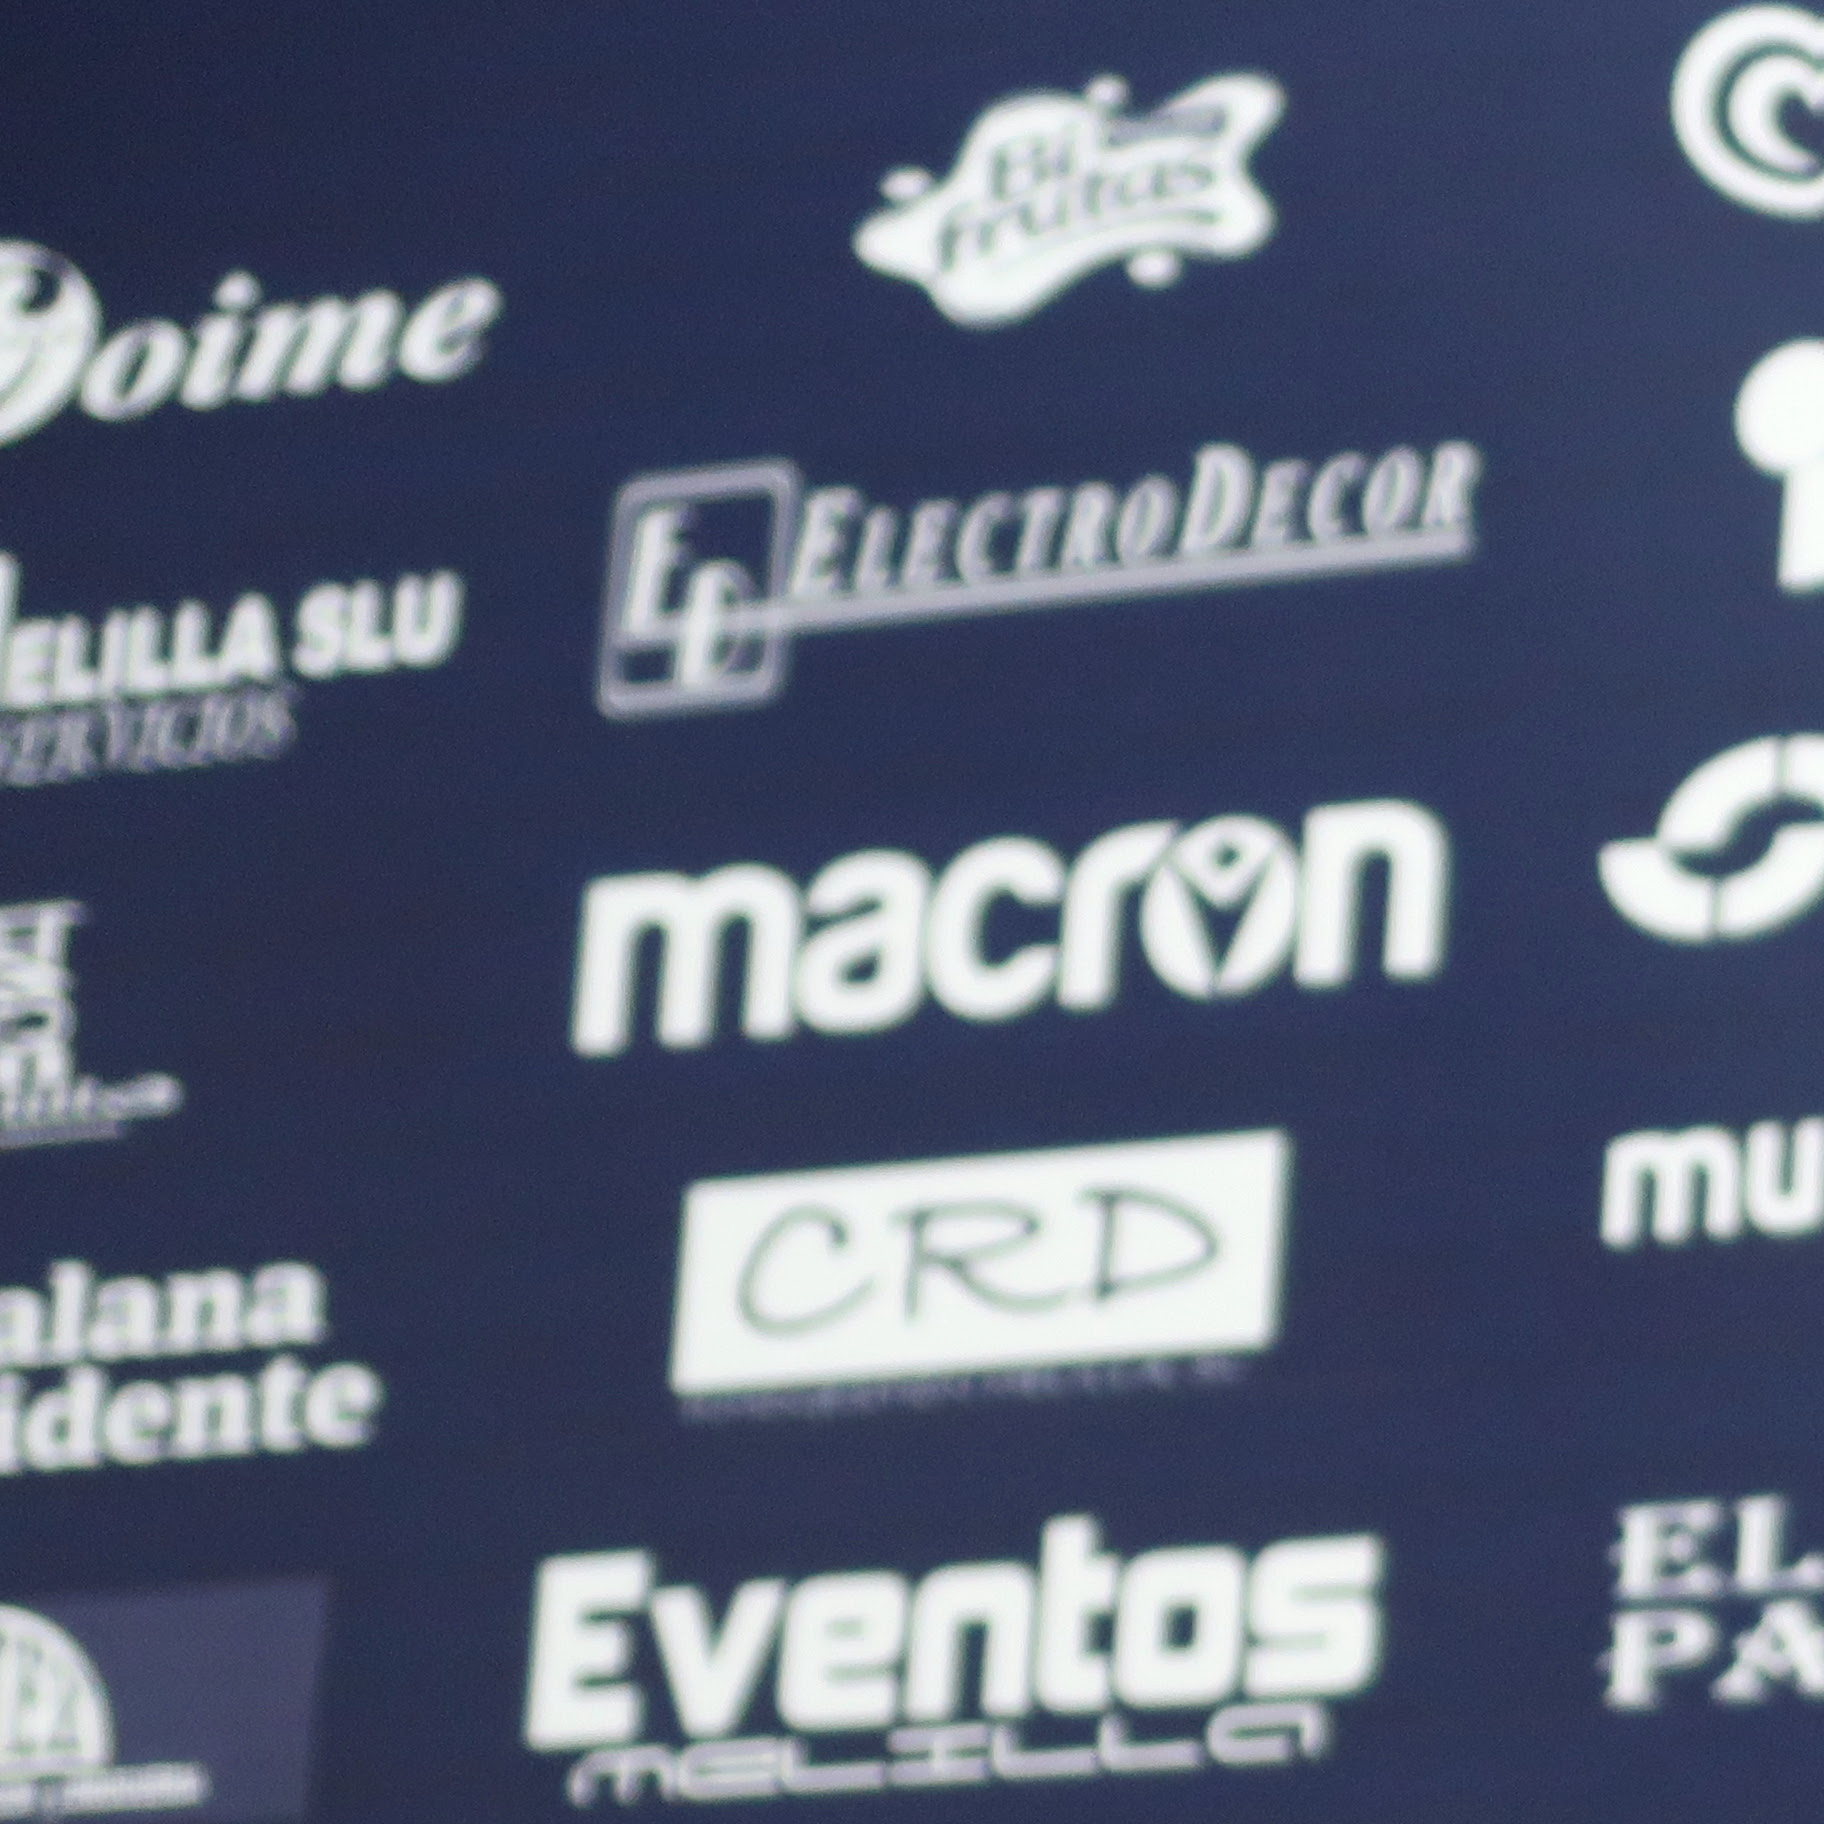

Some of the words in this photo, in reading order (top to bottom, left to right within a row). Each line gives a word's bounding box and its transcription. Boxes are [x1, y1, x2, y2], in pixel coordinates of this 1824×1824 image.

[0, 550, 284, 712] ELILLA
[291, 568, 466, 680] SLU
[570, 798, 1452, 1060] macron
[738, 1184, 1220, 1336] CRD
[524, 1511, 1386, 1752] Eventos
